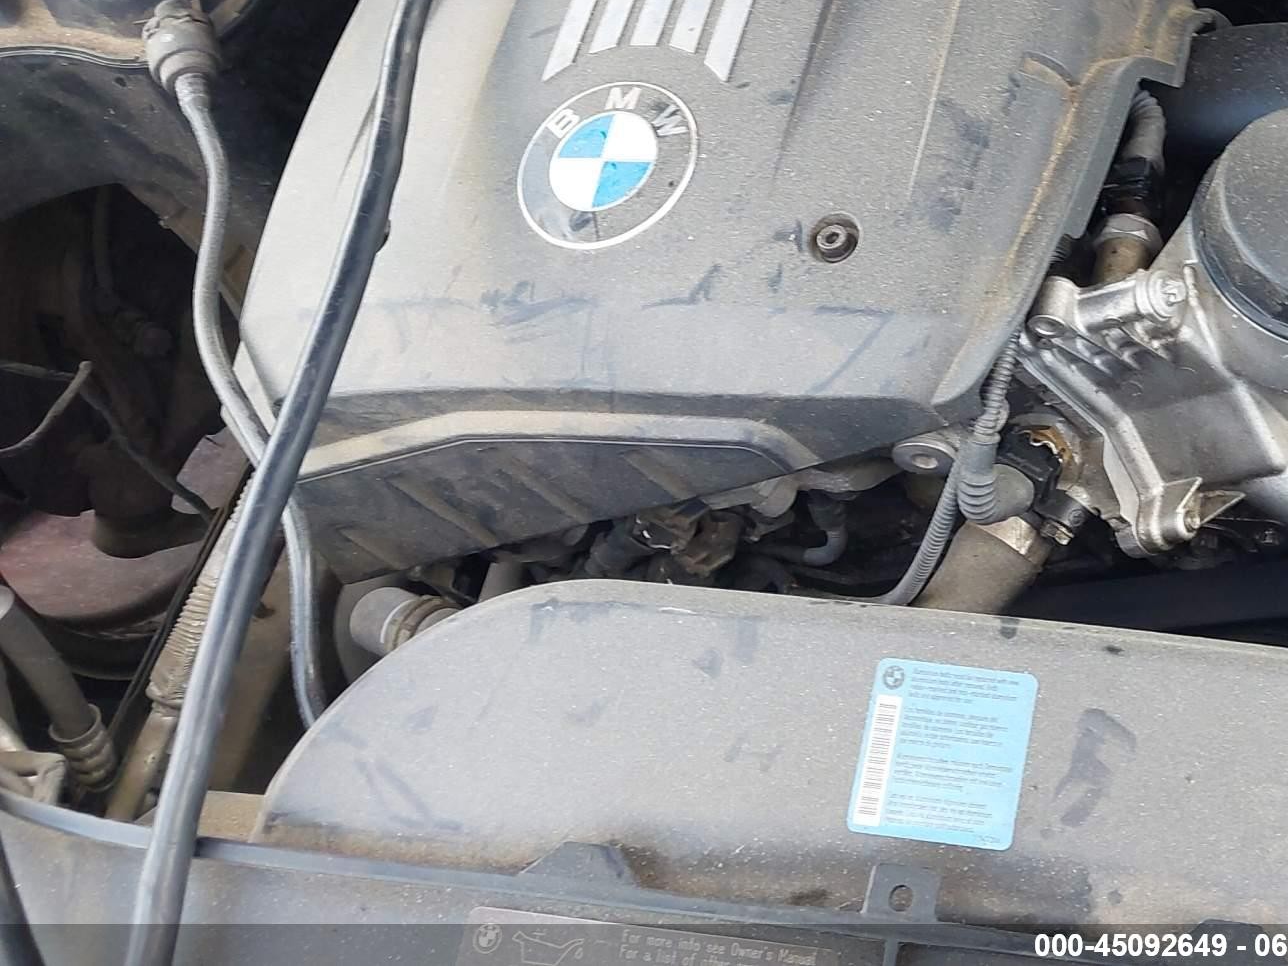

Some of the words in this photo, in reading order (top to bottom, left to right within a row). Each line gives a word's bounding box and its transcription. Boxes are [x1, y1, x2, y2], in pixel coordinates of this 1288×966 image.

[545, 87, 690, 139] BMW
[619, 944, 639, 960] For
[643, 952, 652, 962] a
[622, 929, 641, 944] For
[646, 936, 673, 948] more
[678, 938, 700, 952] info
[705, 944, 725, 955] see
[731, 942, 772, 962] Owner's
